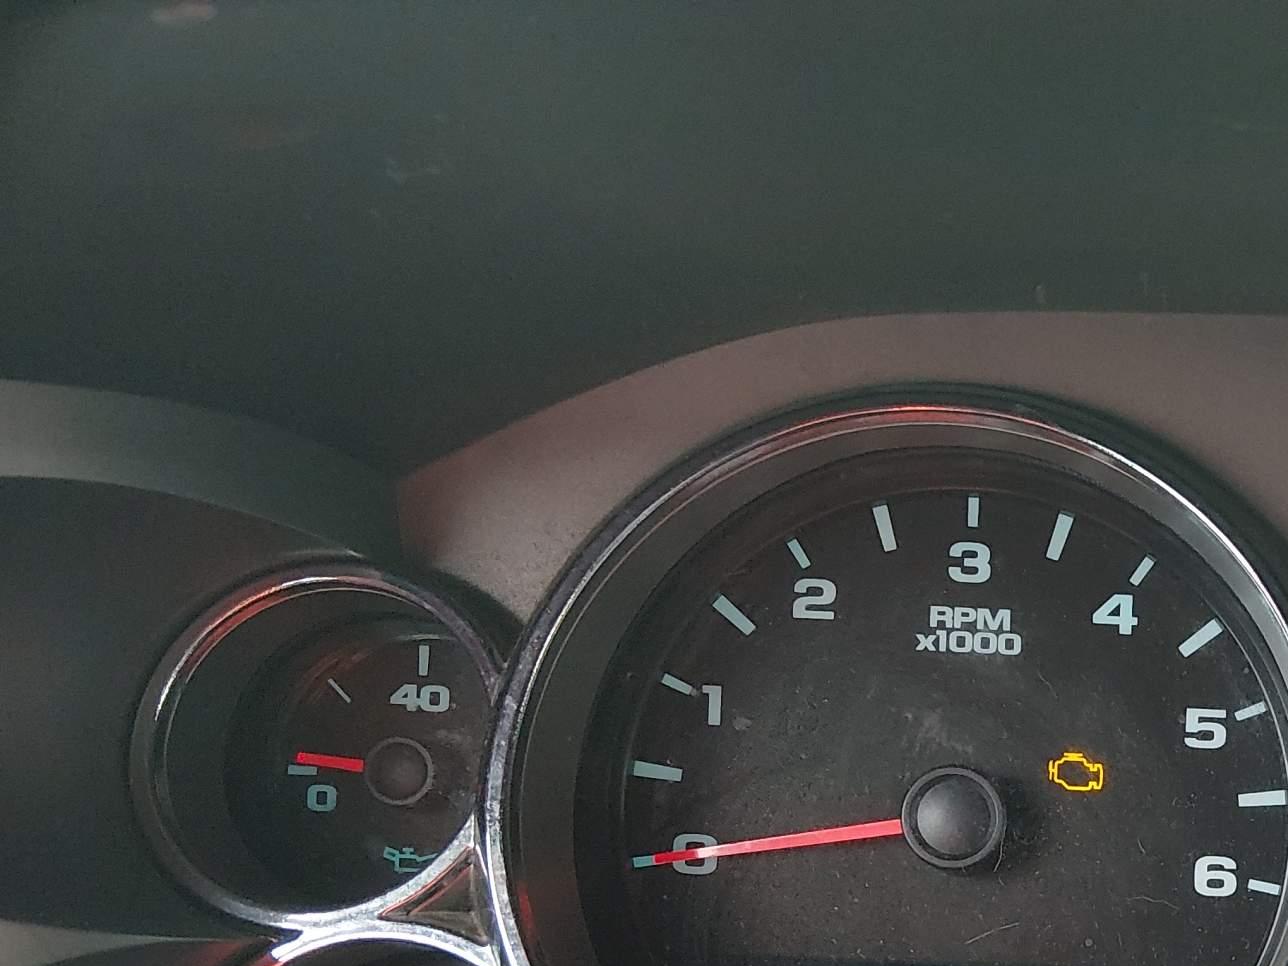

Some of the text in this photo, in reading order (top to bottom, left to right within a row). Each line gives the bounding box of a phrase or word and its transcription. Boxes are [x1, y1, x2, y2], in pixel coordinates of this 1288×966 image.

[948, 541, 992, 584] 3
[791, 577, 837, 620] 2
[929, 606, 1011, 631] RPM
[1092, 594, 1139, 635] 4
[915, 632, 1022, 656] x1000
[389, 683, 451, 714] 40
[701, 685, 722, 726] 1
[1184, 707, 1228, 750] 5
[306, 784, 338, 812] 0
[672, 833, 719, 876] 0
[1194, 855, 1238, 898] 6
